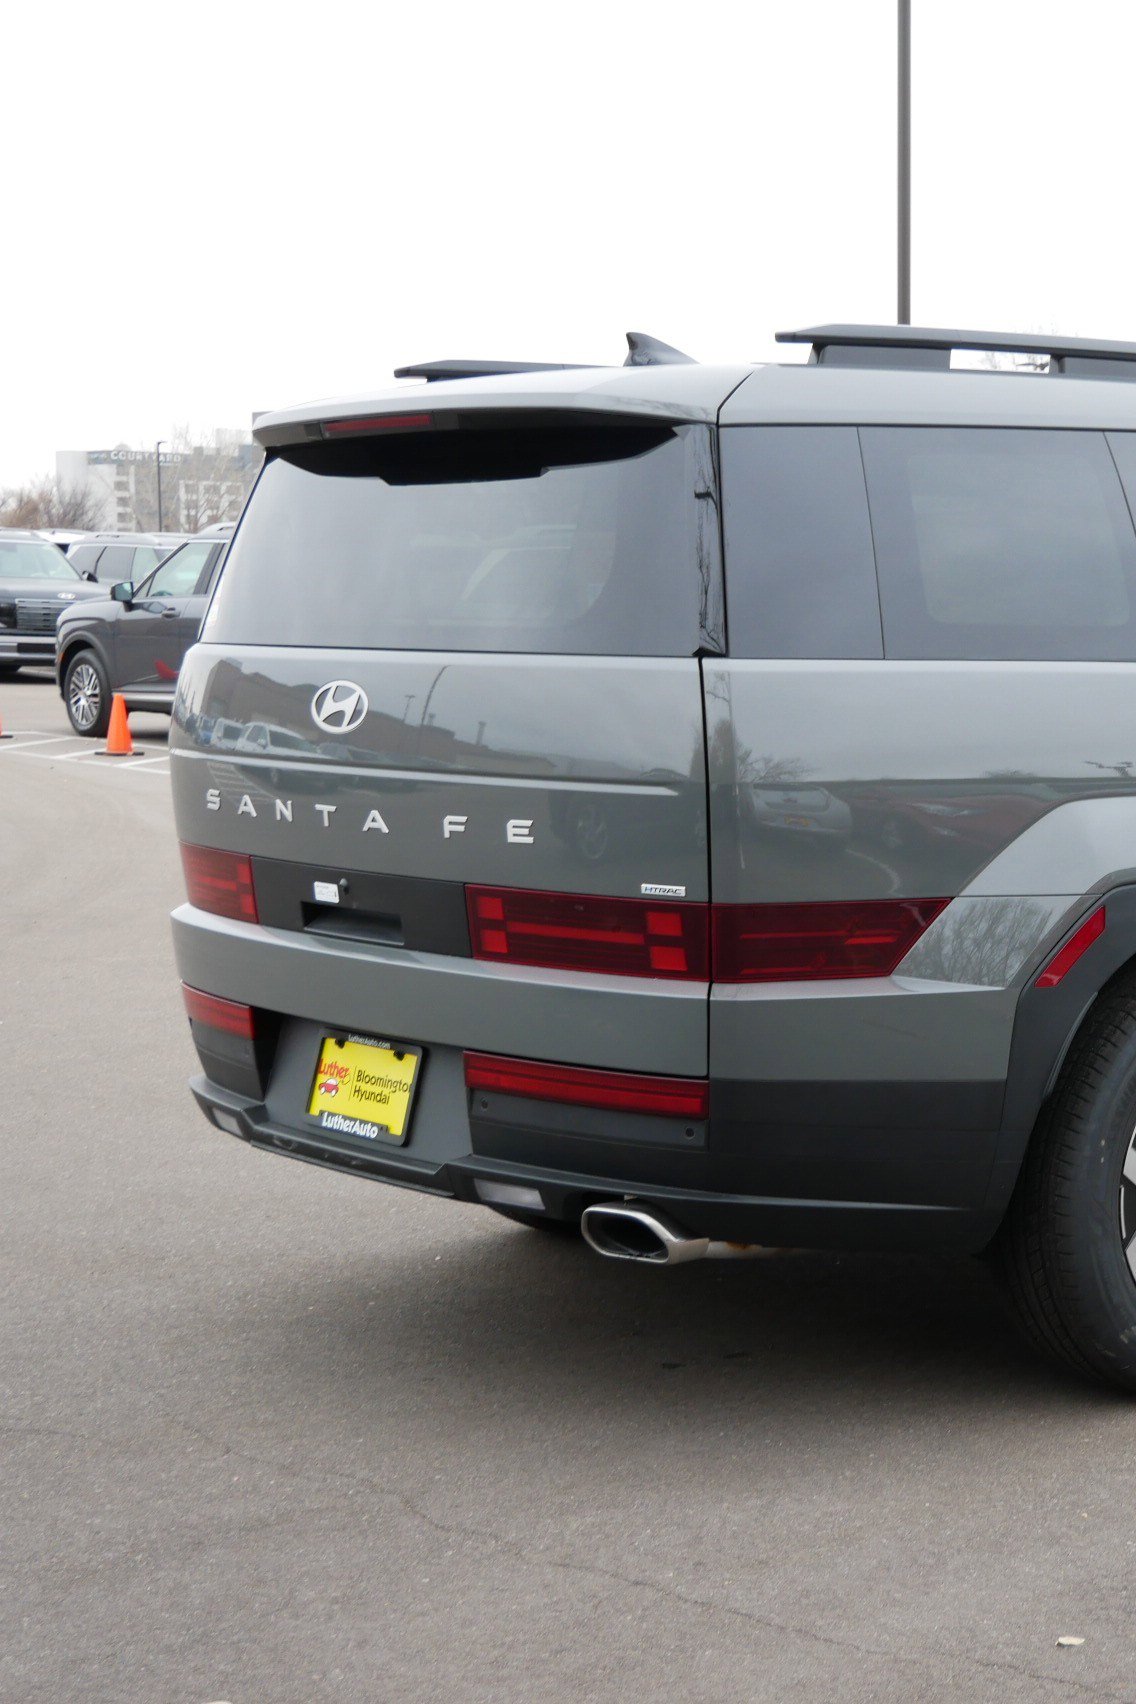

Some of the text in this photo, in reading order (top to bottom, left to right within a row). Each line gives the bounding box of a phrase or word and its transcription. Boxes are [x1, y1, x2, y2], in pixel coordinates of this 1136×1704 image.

[206, 788, 534, 844] SANTA FE
[318, 1059, 349, 1079] Luther
[353, 1085, 391, 1106] Hyundai
[321, 1112, 379, 1138] LutherAuto
